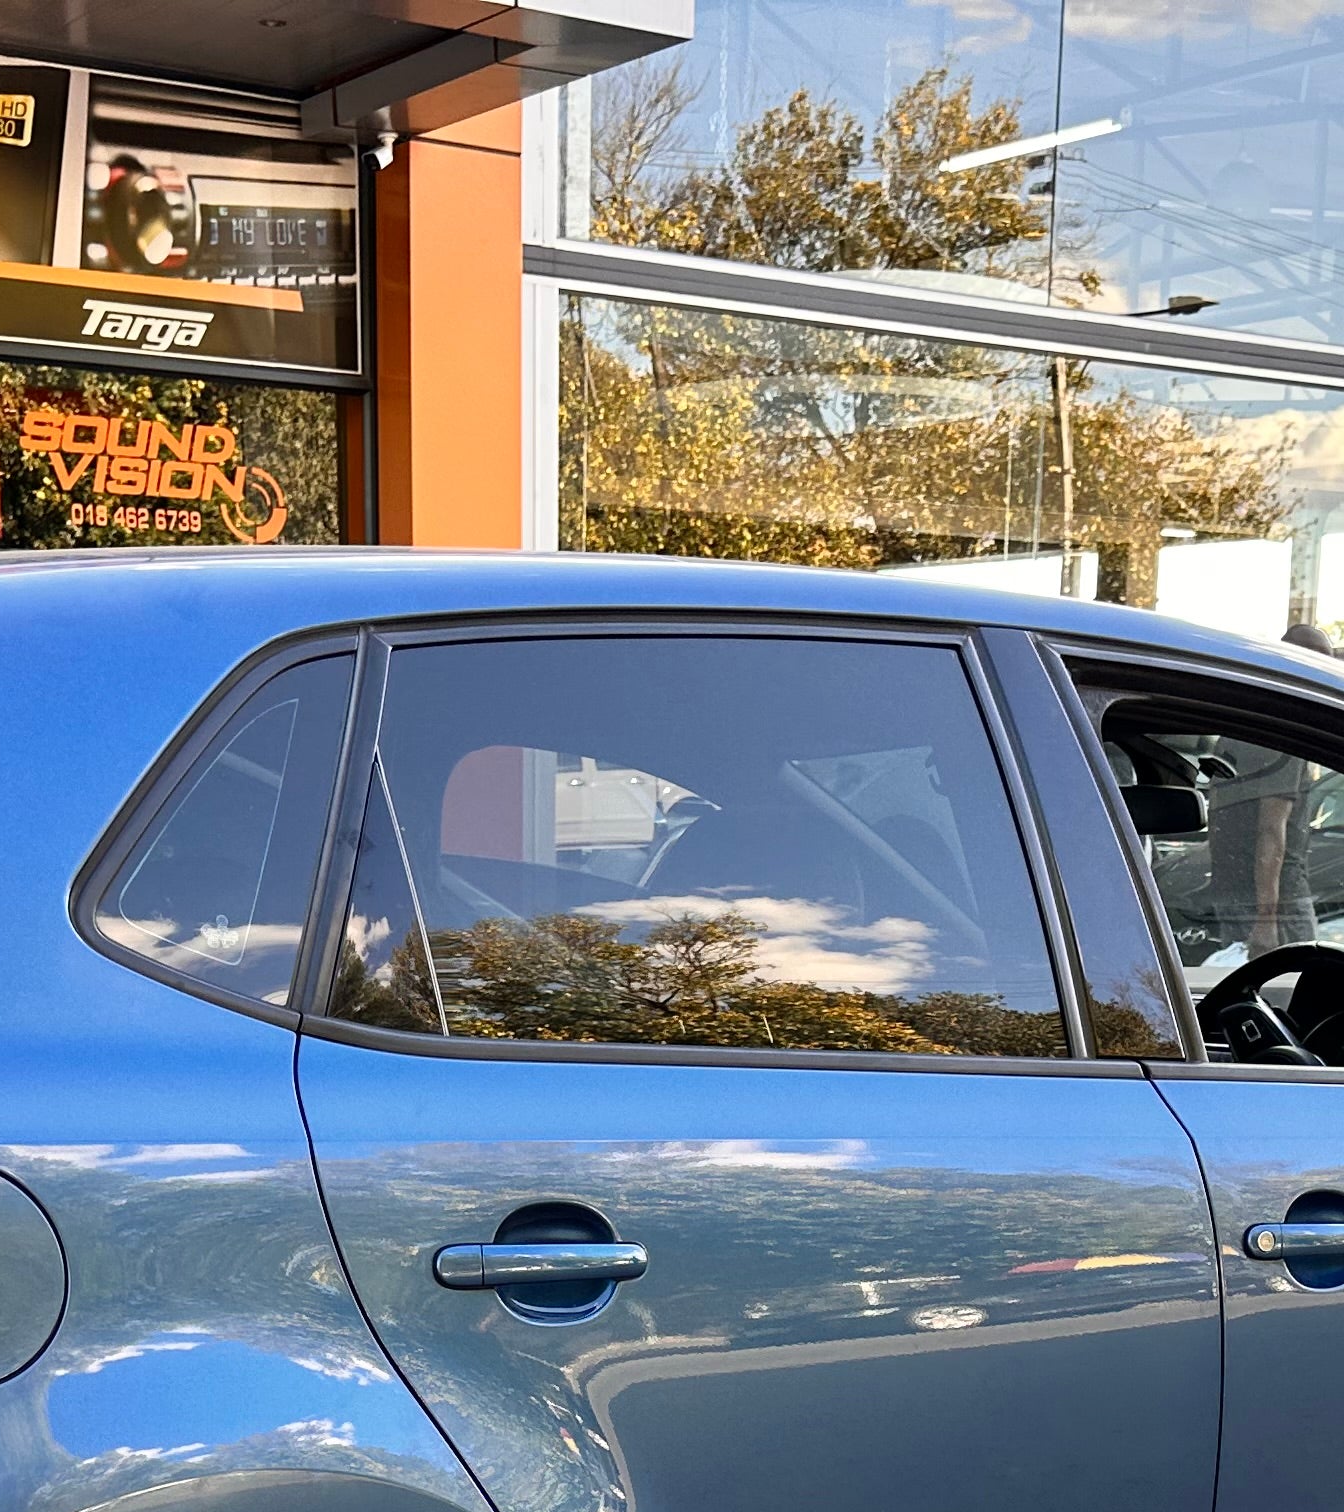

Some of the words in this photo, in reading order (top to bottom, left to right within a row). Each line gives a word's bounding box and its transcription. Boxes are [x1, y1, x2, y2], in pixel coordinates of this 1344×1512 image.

[1, 101, 27, 117] HD
[81, 299, 215, 352] Targa
[19, 410, 236, 464] SOUND
[49, 451, 247, 503] VISION
[71, 503, 108, 527] 018
[113, 506, 150, 530] 462
[155, 509, 202, 533] 6739
